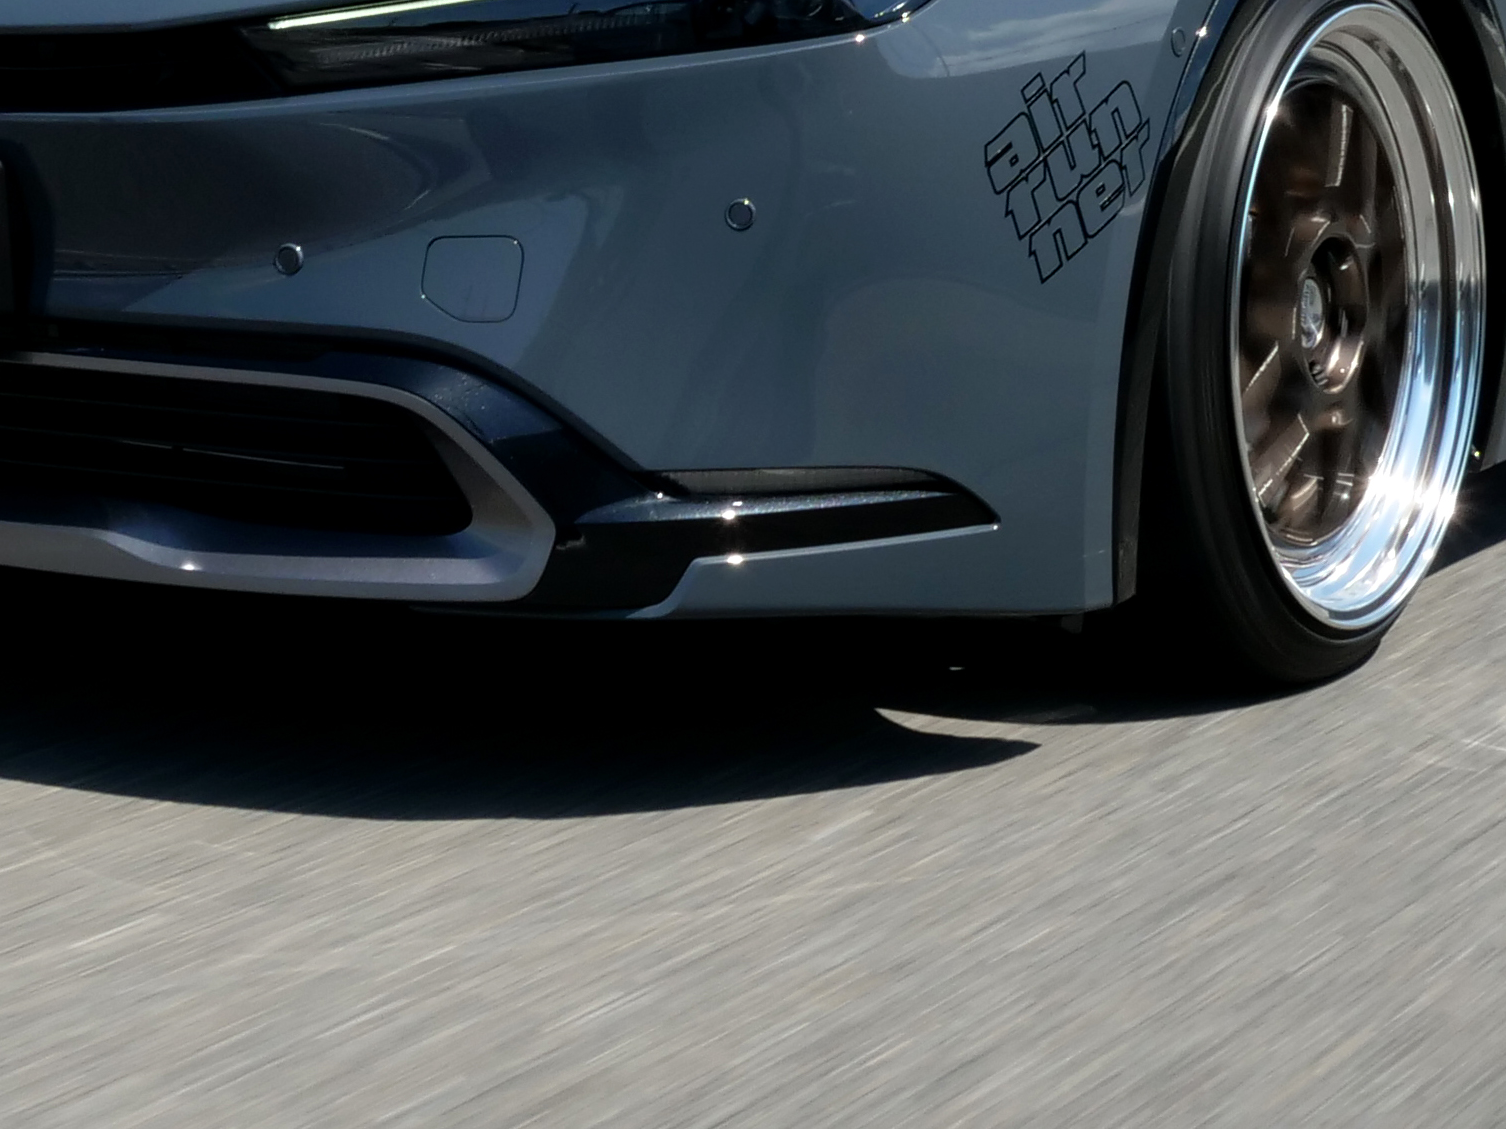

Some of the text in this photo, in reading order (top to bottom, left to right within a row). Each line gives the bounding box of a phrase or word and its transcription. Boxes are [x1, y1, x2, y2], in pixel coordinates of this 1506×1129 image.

[984, 50, 1086, 195] air
[1005, 80, 1143, 241] run
[1028, 118, 1150, 284] ner
